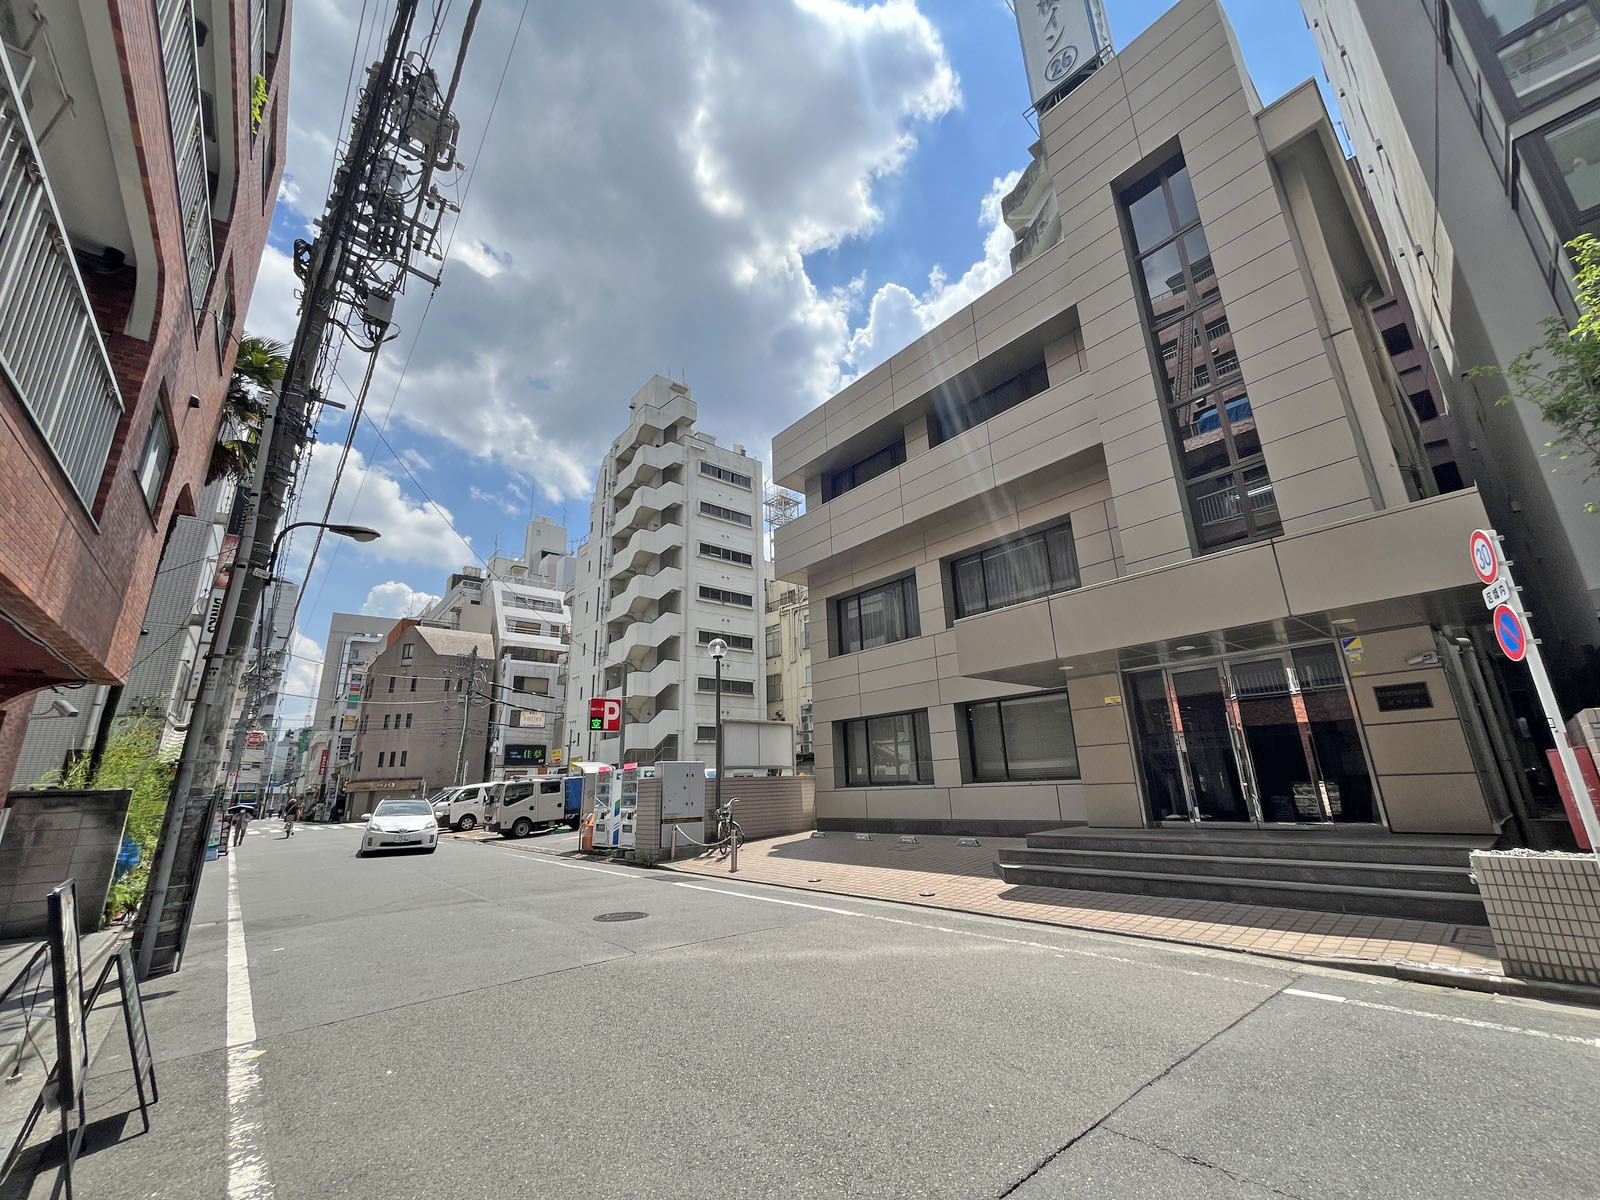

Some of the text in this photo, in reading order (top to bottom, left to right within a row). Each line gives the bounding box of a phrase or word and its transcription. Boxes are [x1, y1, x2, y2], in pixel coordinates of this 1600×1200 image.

[1475, 543, 1491, 570] 30
[591, 718, 602, 729] 空
[603, 701, 620, 729] P
